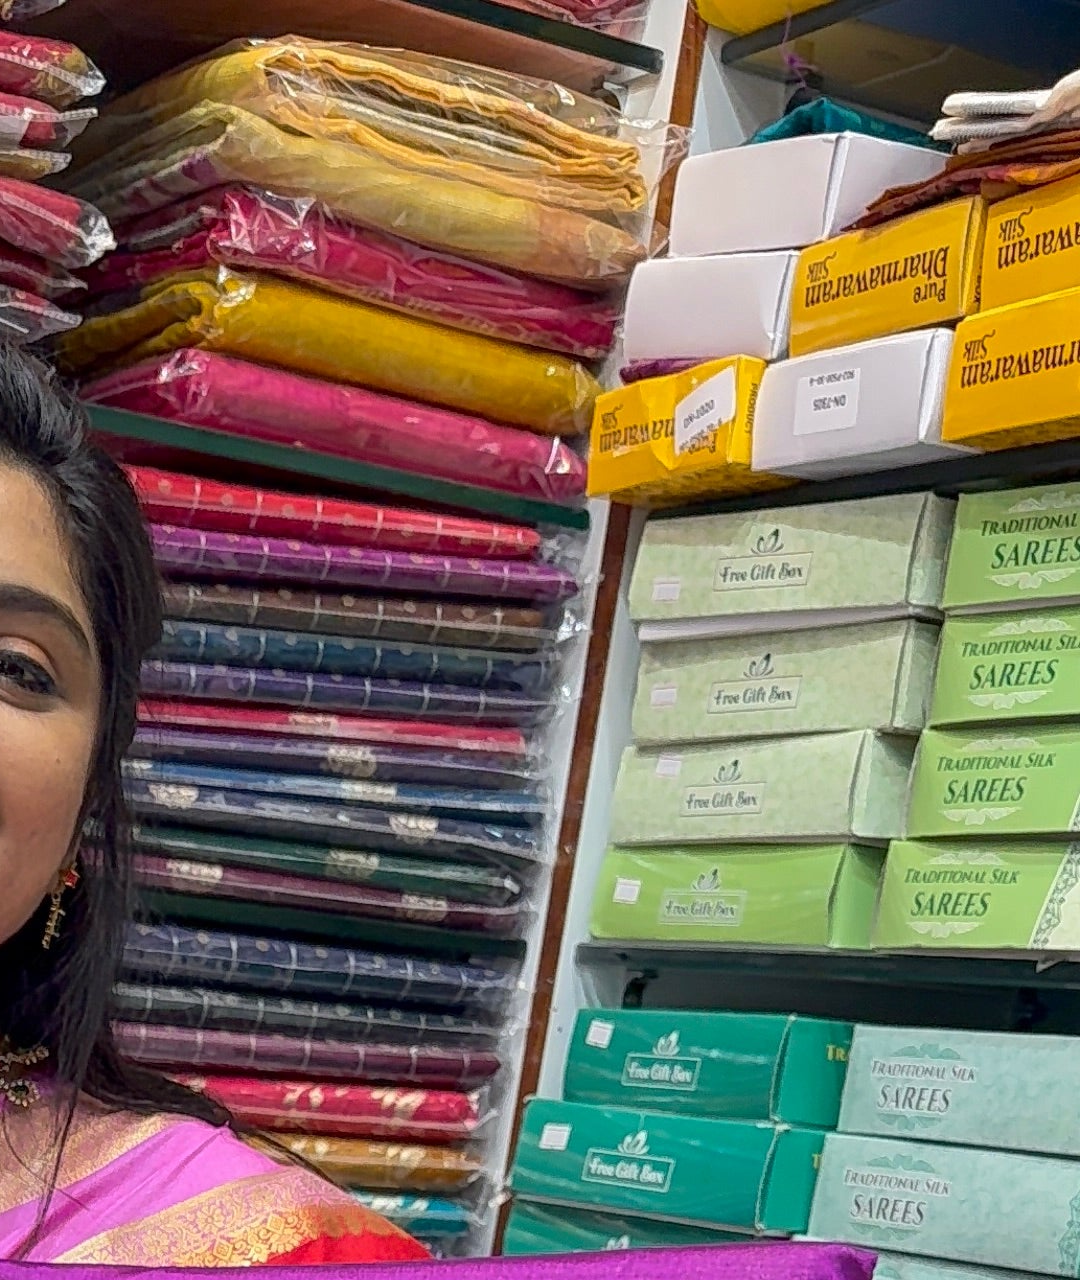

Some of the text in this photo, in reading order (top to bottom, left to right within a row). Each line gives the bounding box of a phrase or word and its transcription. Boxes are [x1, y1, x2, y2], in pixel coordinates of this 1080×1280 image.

[999, 206, 1033, 243] Silk
[805, 246, 950, 308] Dharmawaram
[807, 251, 837, 282] Silk
[913, 279, 946, 303] Pure
[963, 329, 996, 362] Silk
[960, 339, 1080, 389] rmawaram
[981, 513, 1078, 536] TRADITIONAL
[719, 562, 803, 583] Free Gift Box
[962, 634, 1080, 658] TRADITIONAL SIL
[969, 659, 1059, 690] SAREES
[713, 685, 793, 706] Free Gift Box
[937, 752, 1056, 772] TRADITIONAL SILK
[686, 791, 758, 809] Free Gift Box
[943, 776, 1027, 805] SAREES
[904, 868, 1021, 884] TRADITIONAL SILK
[910, 891, 991, 917] SAREES
[627, 1061, 693, 1083] Free Gift Box
[872, 1060, 976, 1082] TRADITIONAL SILK
[877, 1084, 952, 1113] SAREES
[589, 1156, 665, 1184] Free Gift Box
[844, 1169, 951, 1196] TRADITIONAL SILK
[850, 1194, 926, 1225] SAREES
